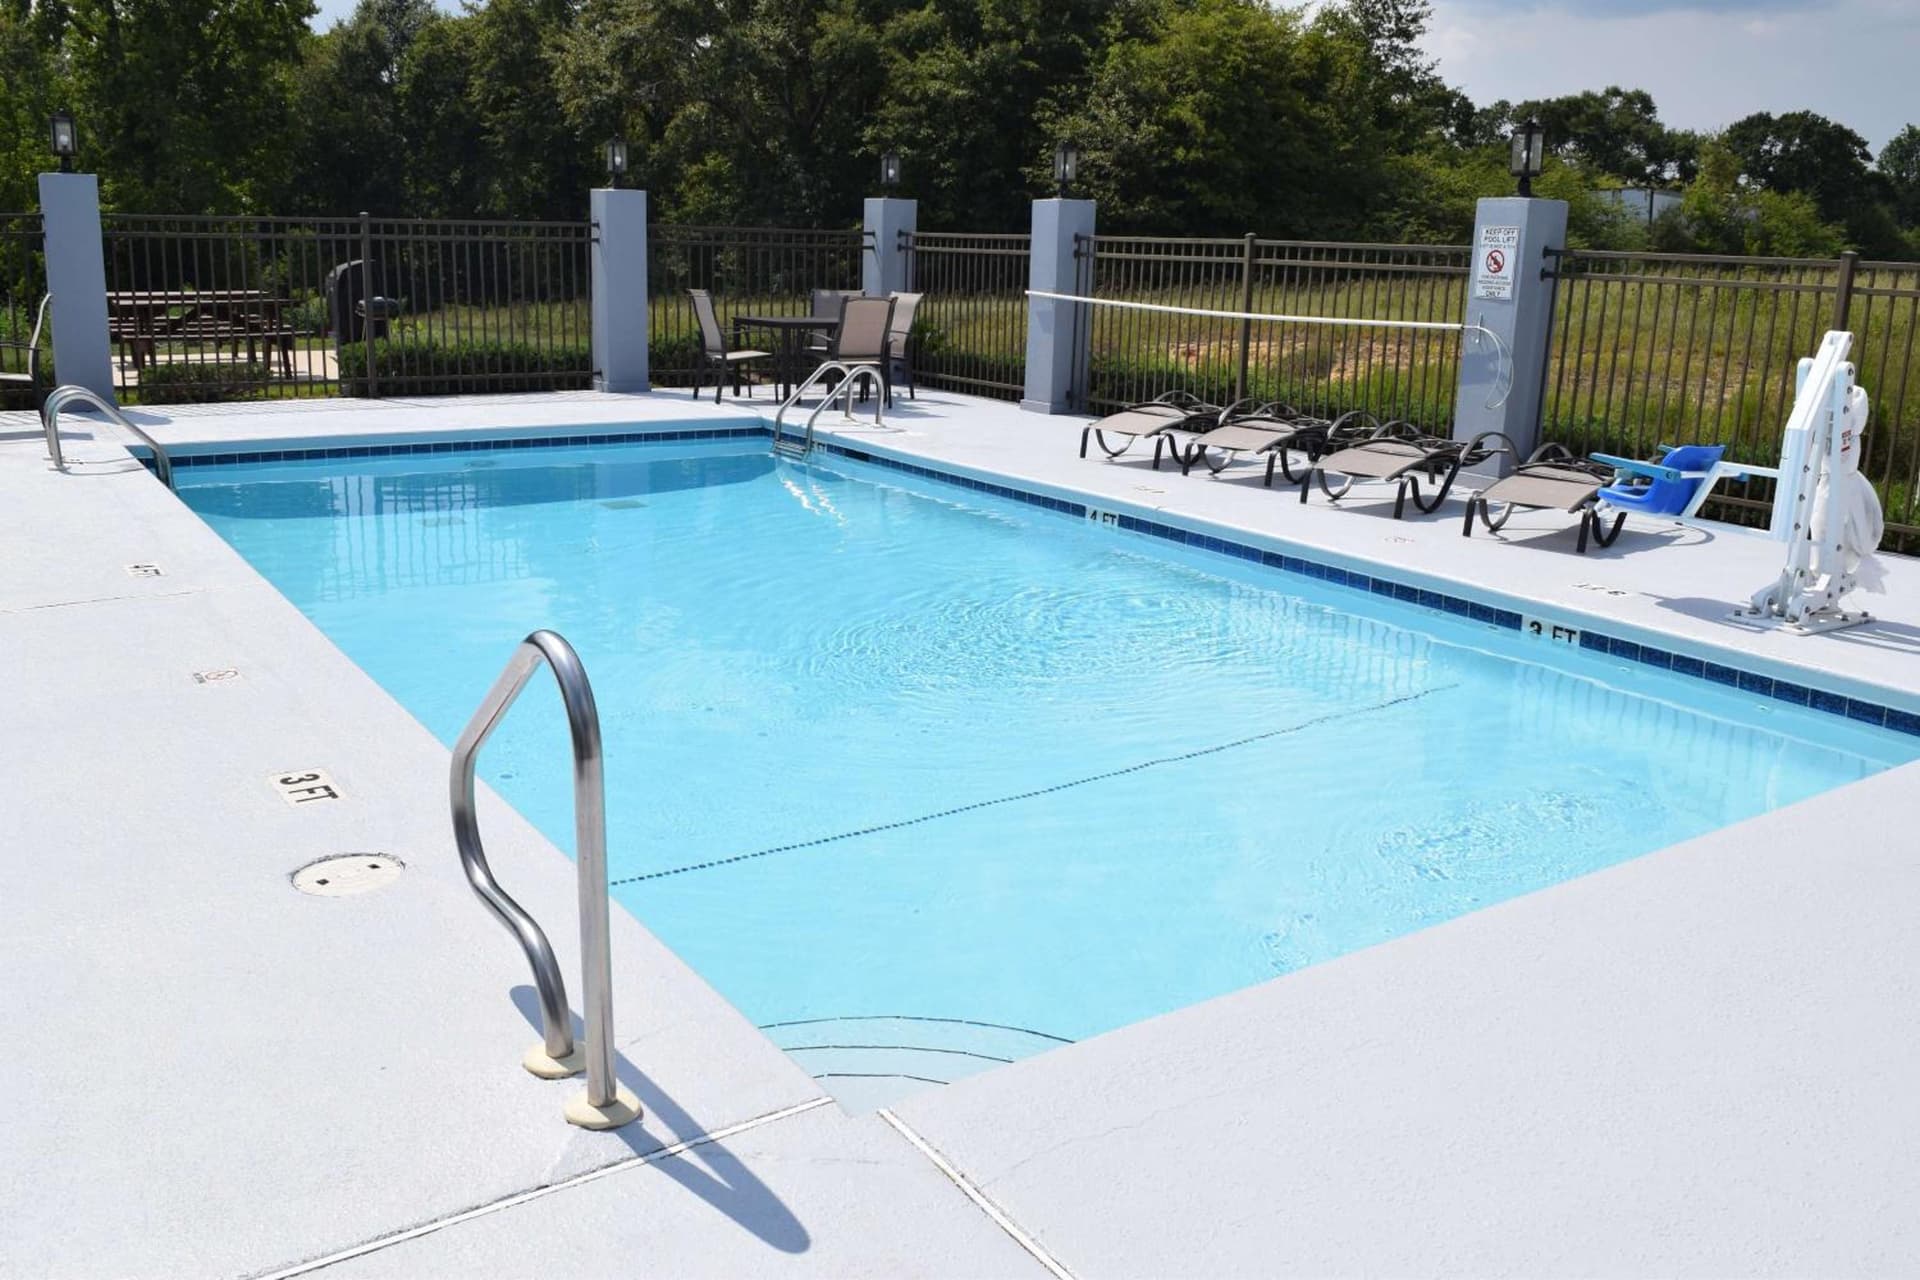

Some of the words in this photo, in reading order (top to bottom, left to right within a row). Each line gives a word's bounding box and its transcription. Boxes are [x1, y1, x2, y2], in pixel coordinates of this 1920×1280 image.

[1503, 228, 1516, 236] OFF
[1102, 511, 1118, 526] FT
[1529, 620, 1543, 635] 3
[1552, 625, 1577, 643] FT
[279, 773, 321, 785] 3
[287, 785, 339, 803] FT
